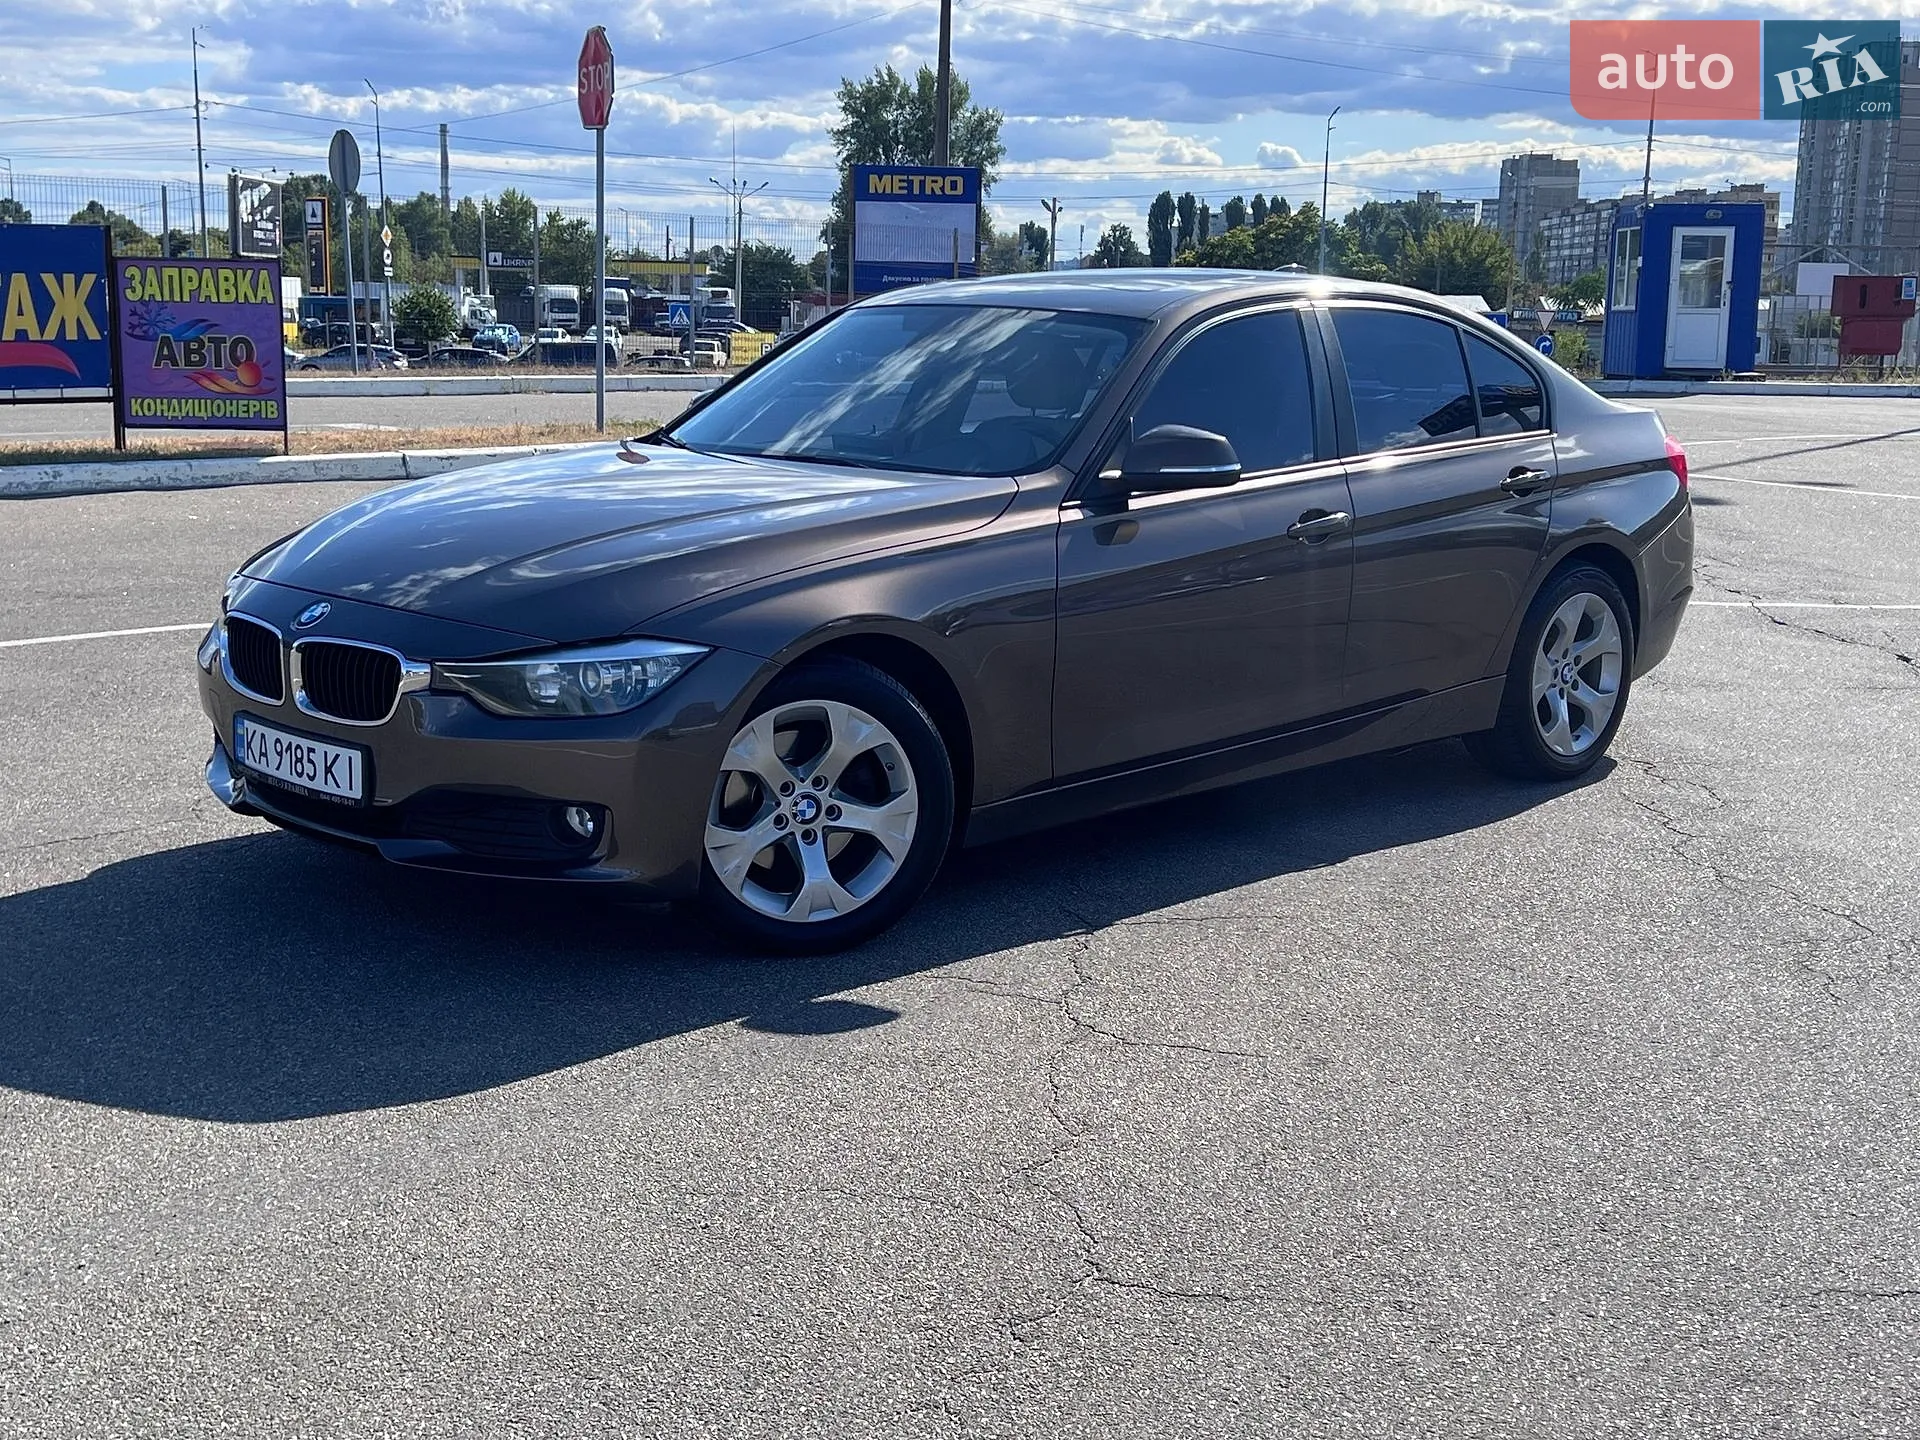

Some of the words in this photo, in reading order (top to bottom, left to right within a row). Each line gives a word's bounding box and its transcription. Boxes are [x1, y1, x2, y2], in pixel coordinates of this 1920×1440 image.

[579, 63, 610, 94] STOP
[868, 174, 964, 196] METRO
[124, 265, 275, 304] ЗАПРАВКА
[0, 272, 102, 341] АЖ
[152, 334, 257, 370] АВТО
[130, 397, 279, 421] КОНДИЦІОНЕРІВ
[246, 727, 270, 768] KA
[273, 737, 317, 782] 9185
[323, 750, 354, 792] KI
